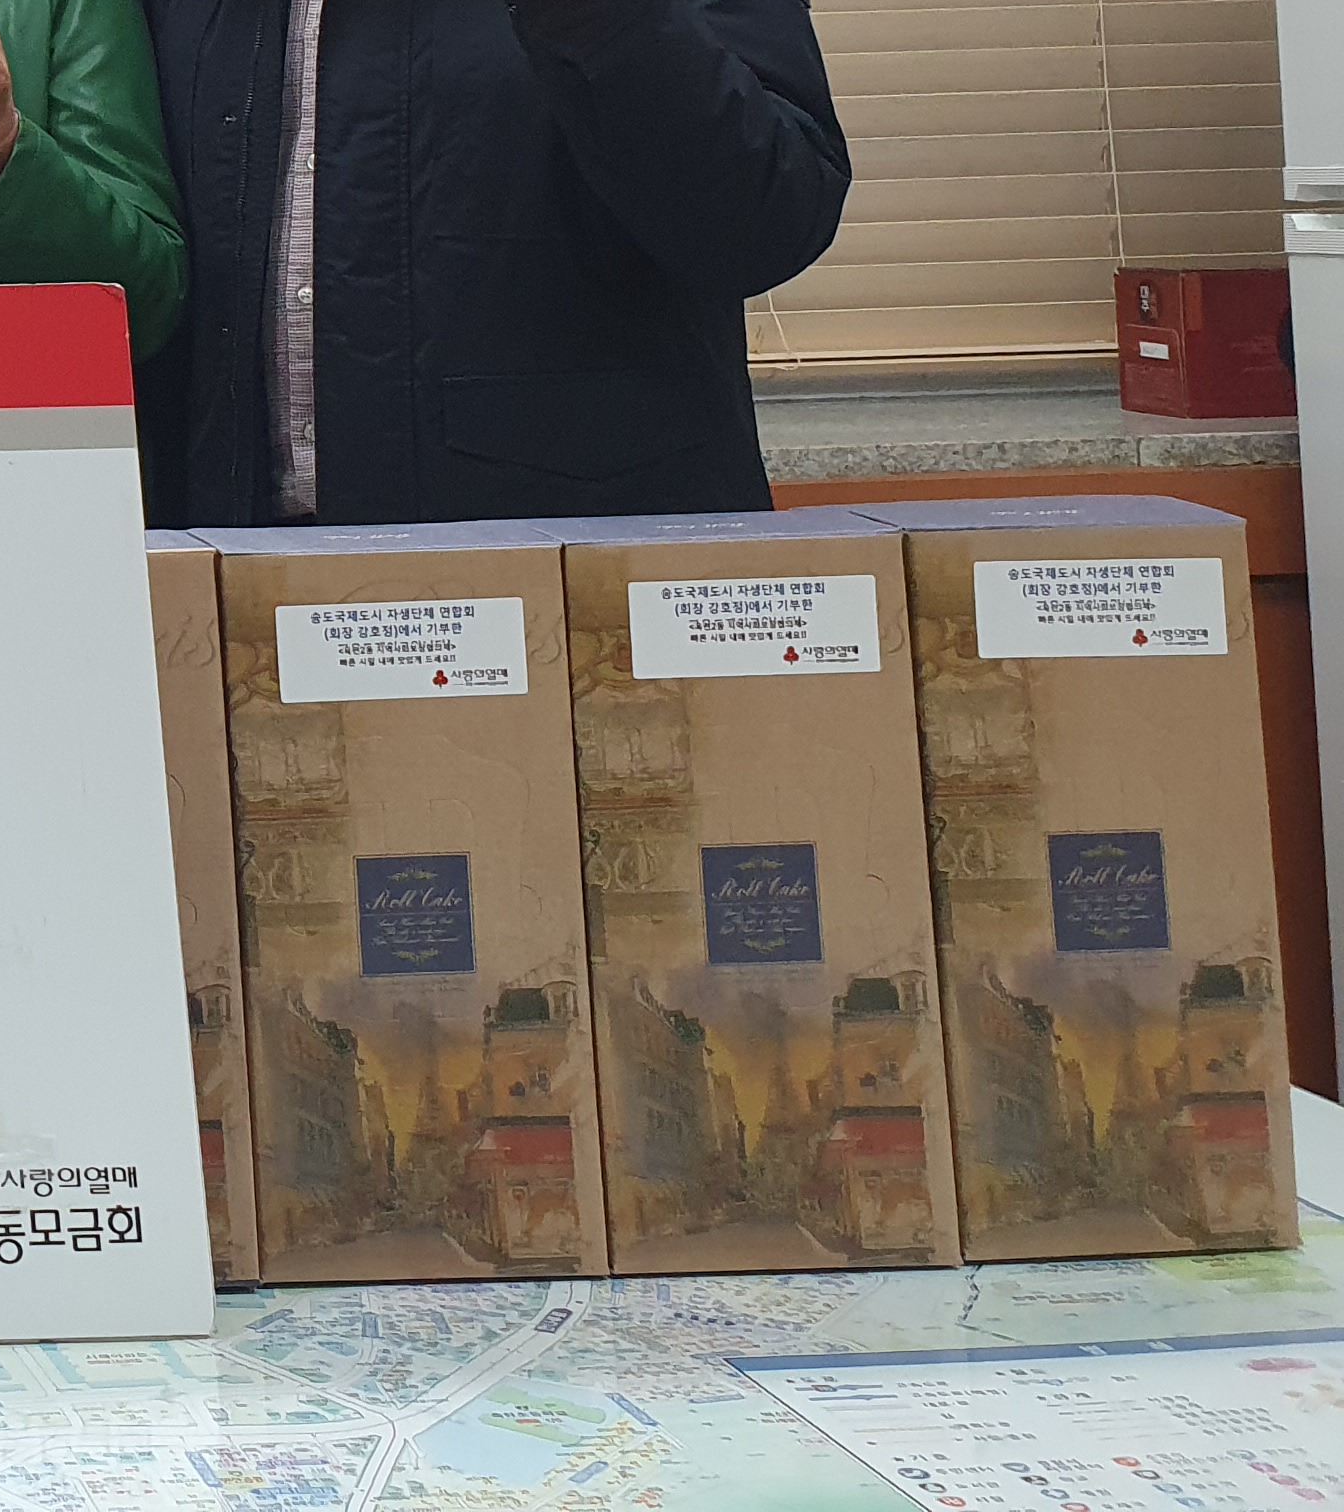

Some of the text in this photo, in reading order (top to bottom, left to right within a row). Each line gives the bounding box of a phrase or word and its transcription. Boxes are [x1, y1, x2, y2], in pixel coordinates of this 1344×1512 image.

[1008, 565, 1174, 580] 송도국제도시 자생단체 연합회
[662, 583, 825, 599] 송도국제도시 자생단체 연합회
[1126, 582, 1161, 594] 기부한
[777, 599, 813, 611] 기부한
[311, 606, 475, 624] 송도국제도시 자생단체 연합회
[427, 622, 462, 635] 기부한
[1, 1167, 138, 1197] 사랑의열매
